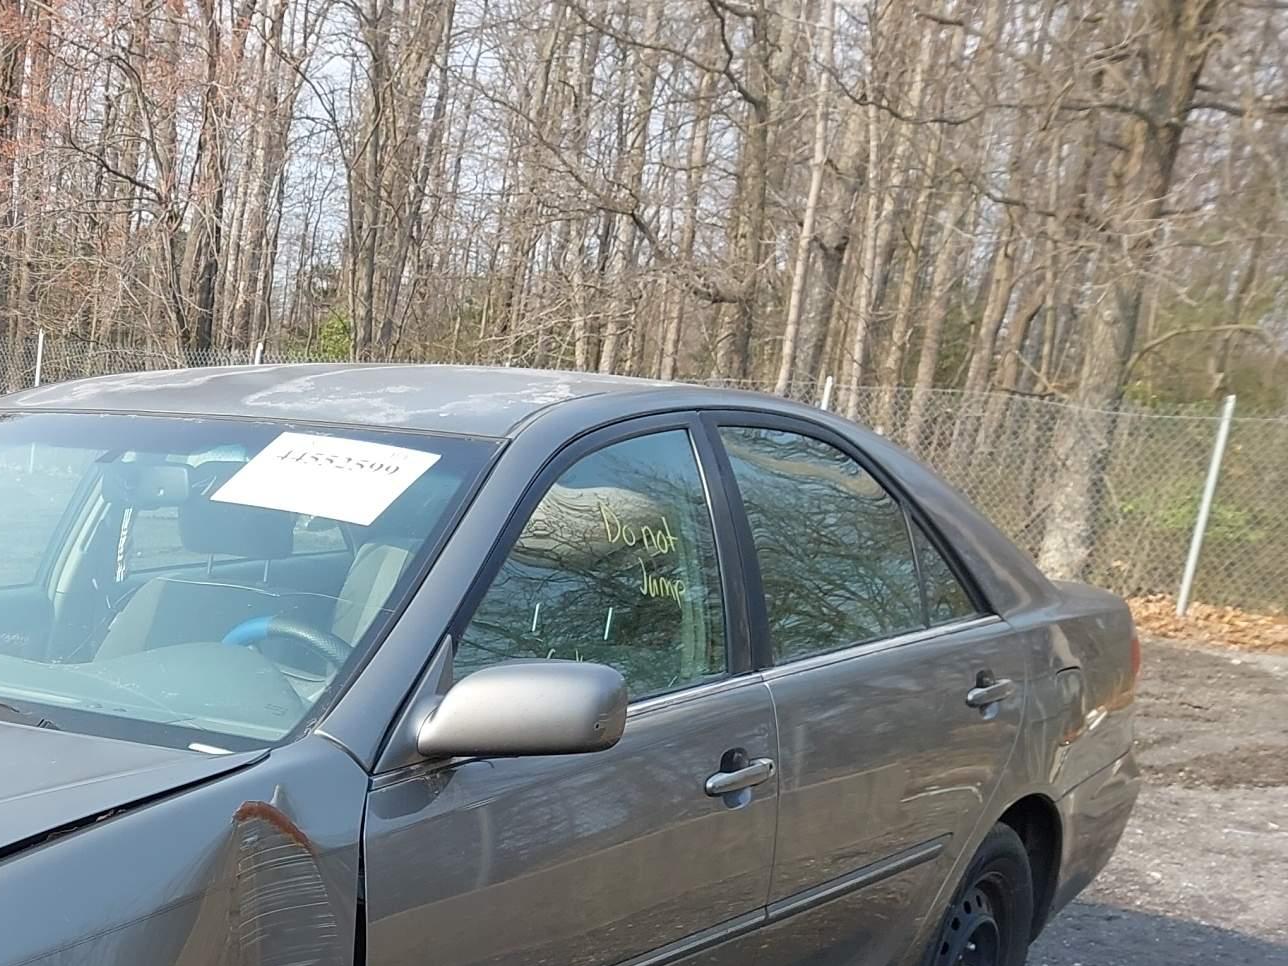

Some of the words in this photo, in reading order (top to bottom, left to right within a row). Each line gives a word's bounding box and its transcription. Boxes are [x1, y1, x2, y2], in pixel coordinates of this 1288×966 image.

[598, 500, 636, 547] Do
[641, 516, 678, 554] not
[638, 556, 686, 609] Jump
